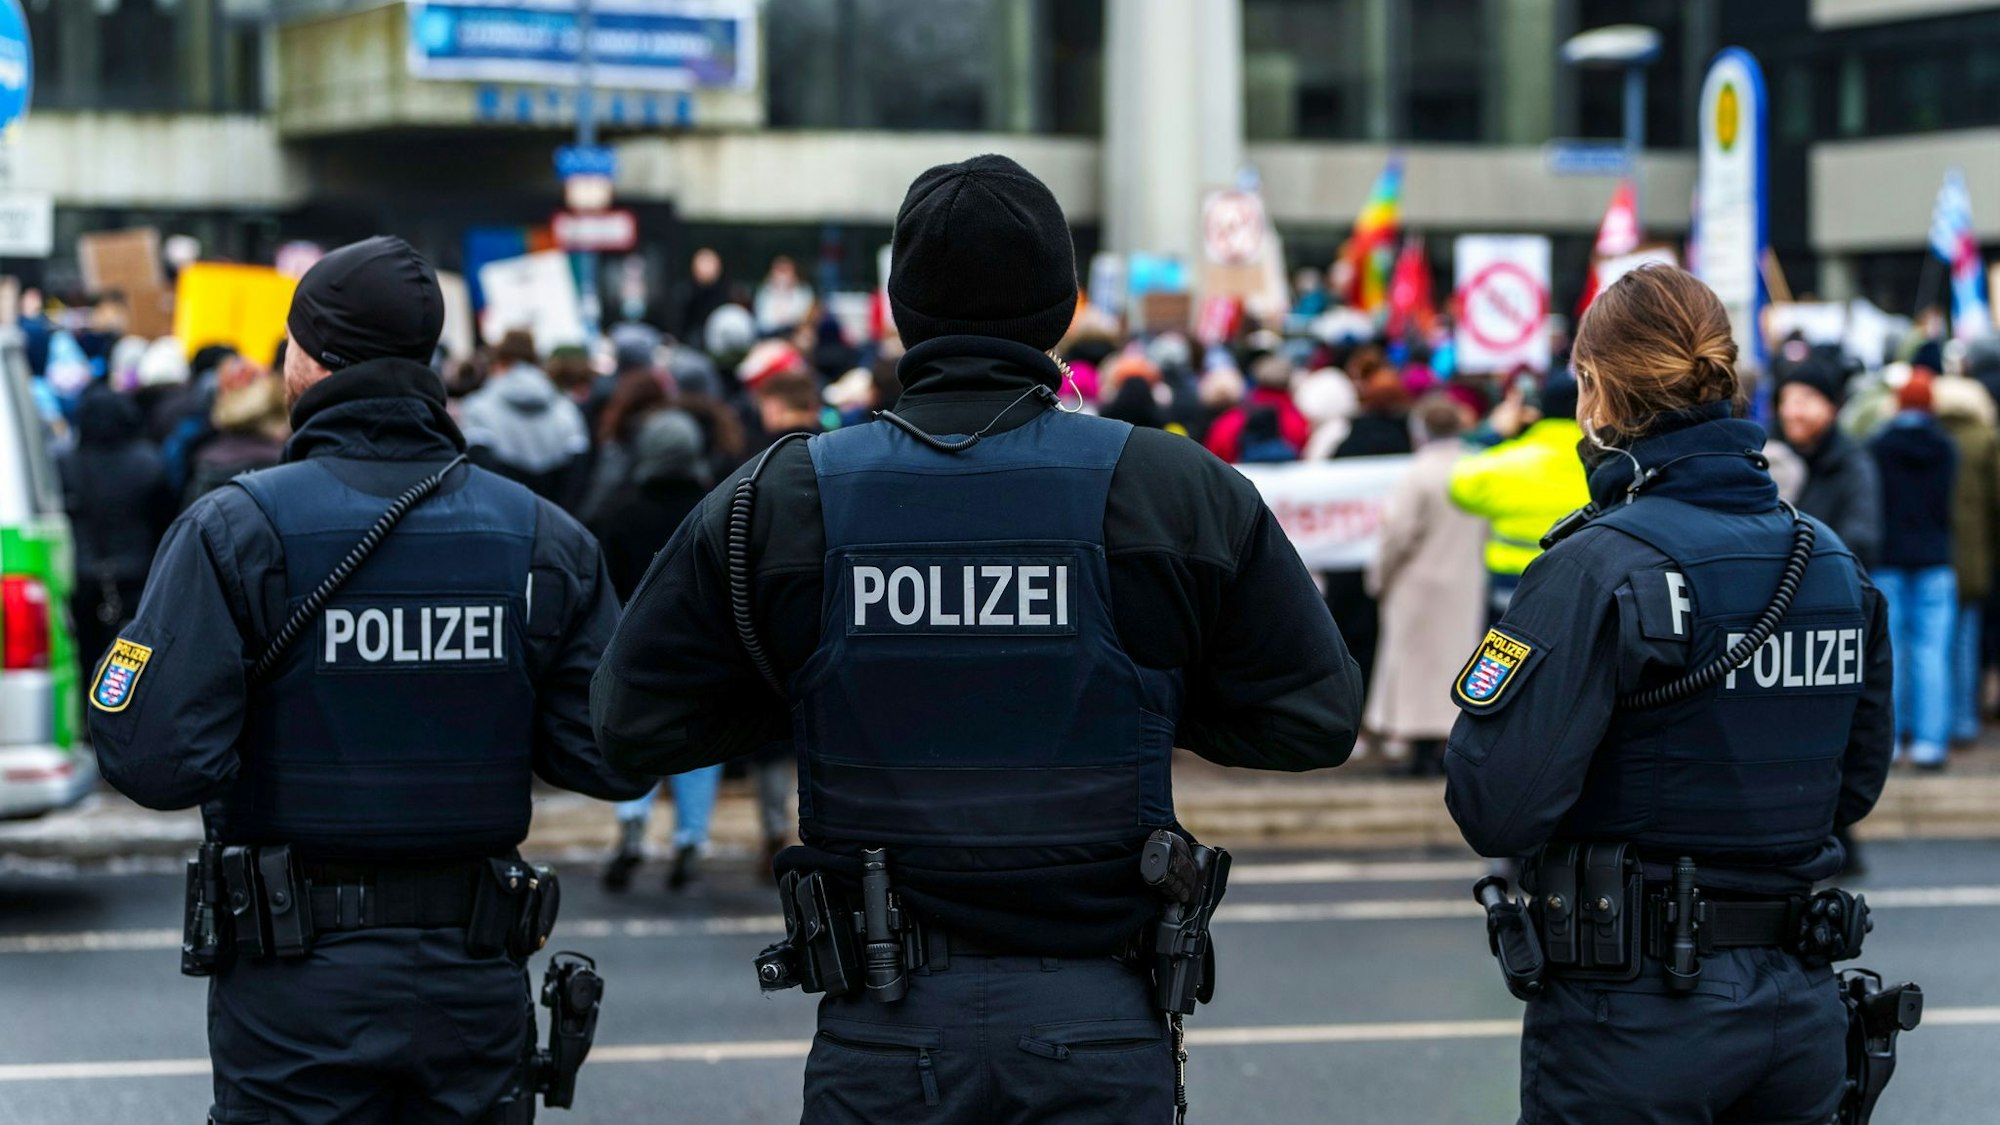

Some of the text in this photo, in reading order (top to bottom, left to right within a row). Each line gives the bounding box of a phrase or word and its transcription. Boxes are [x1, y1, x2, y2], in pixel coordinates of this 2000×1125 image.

[853, 565, 1068, 626] POLIZEI
[325, 606, 504, 663] POLIZEI
[1486, 631, 1528, 660] POLIZEI
